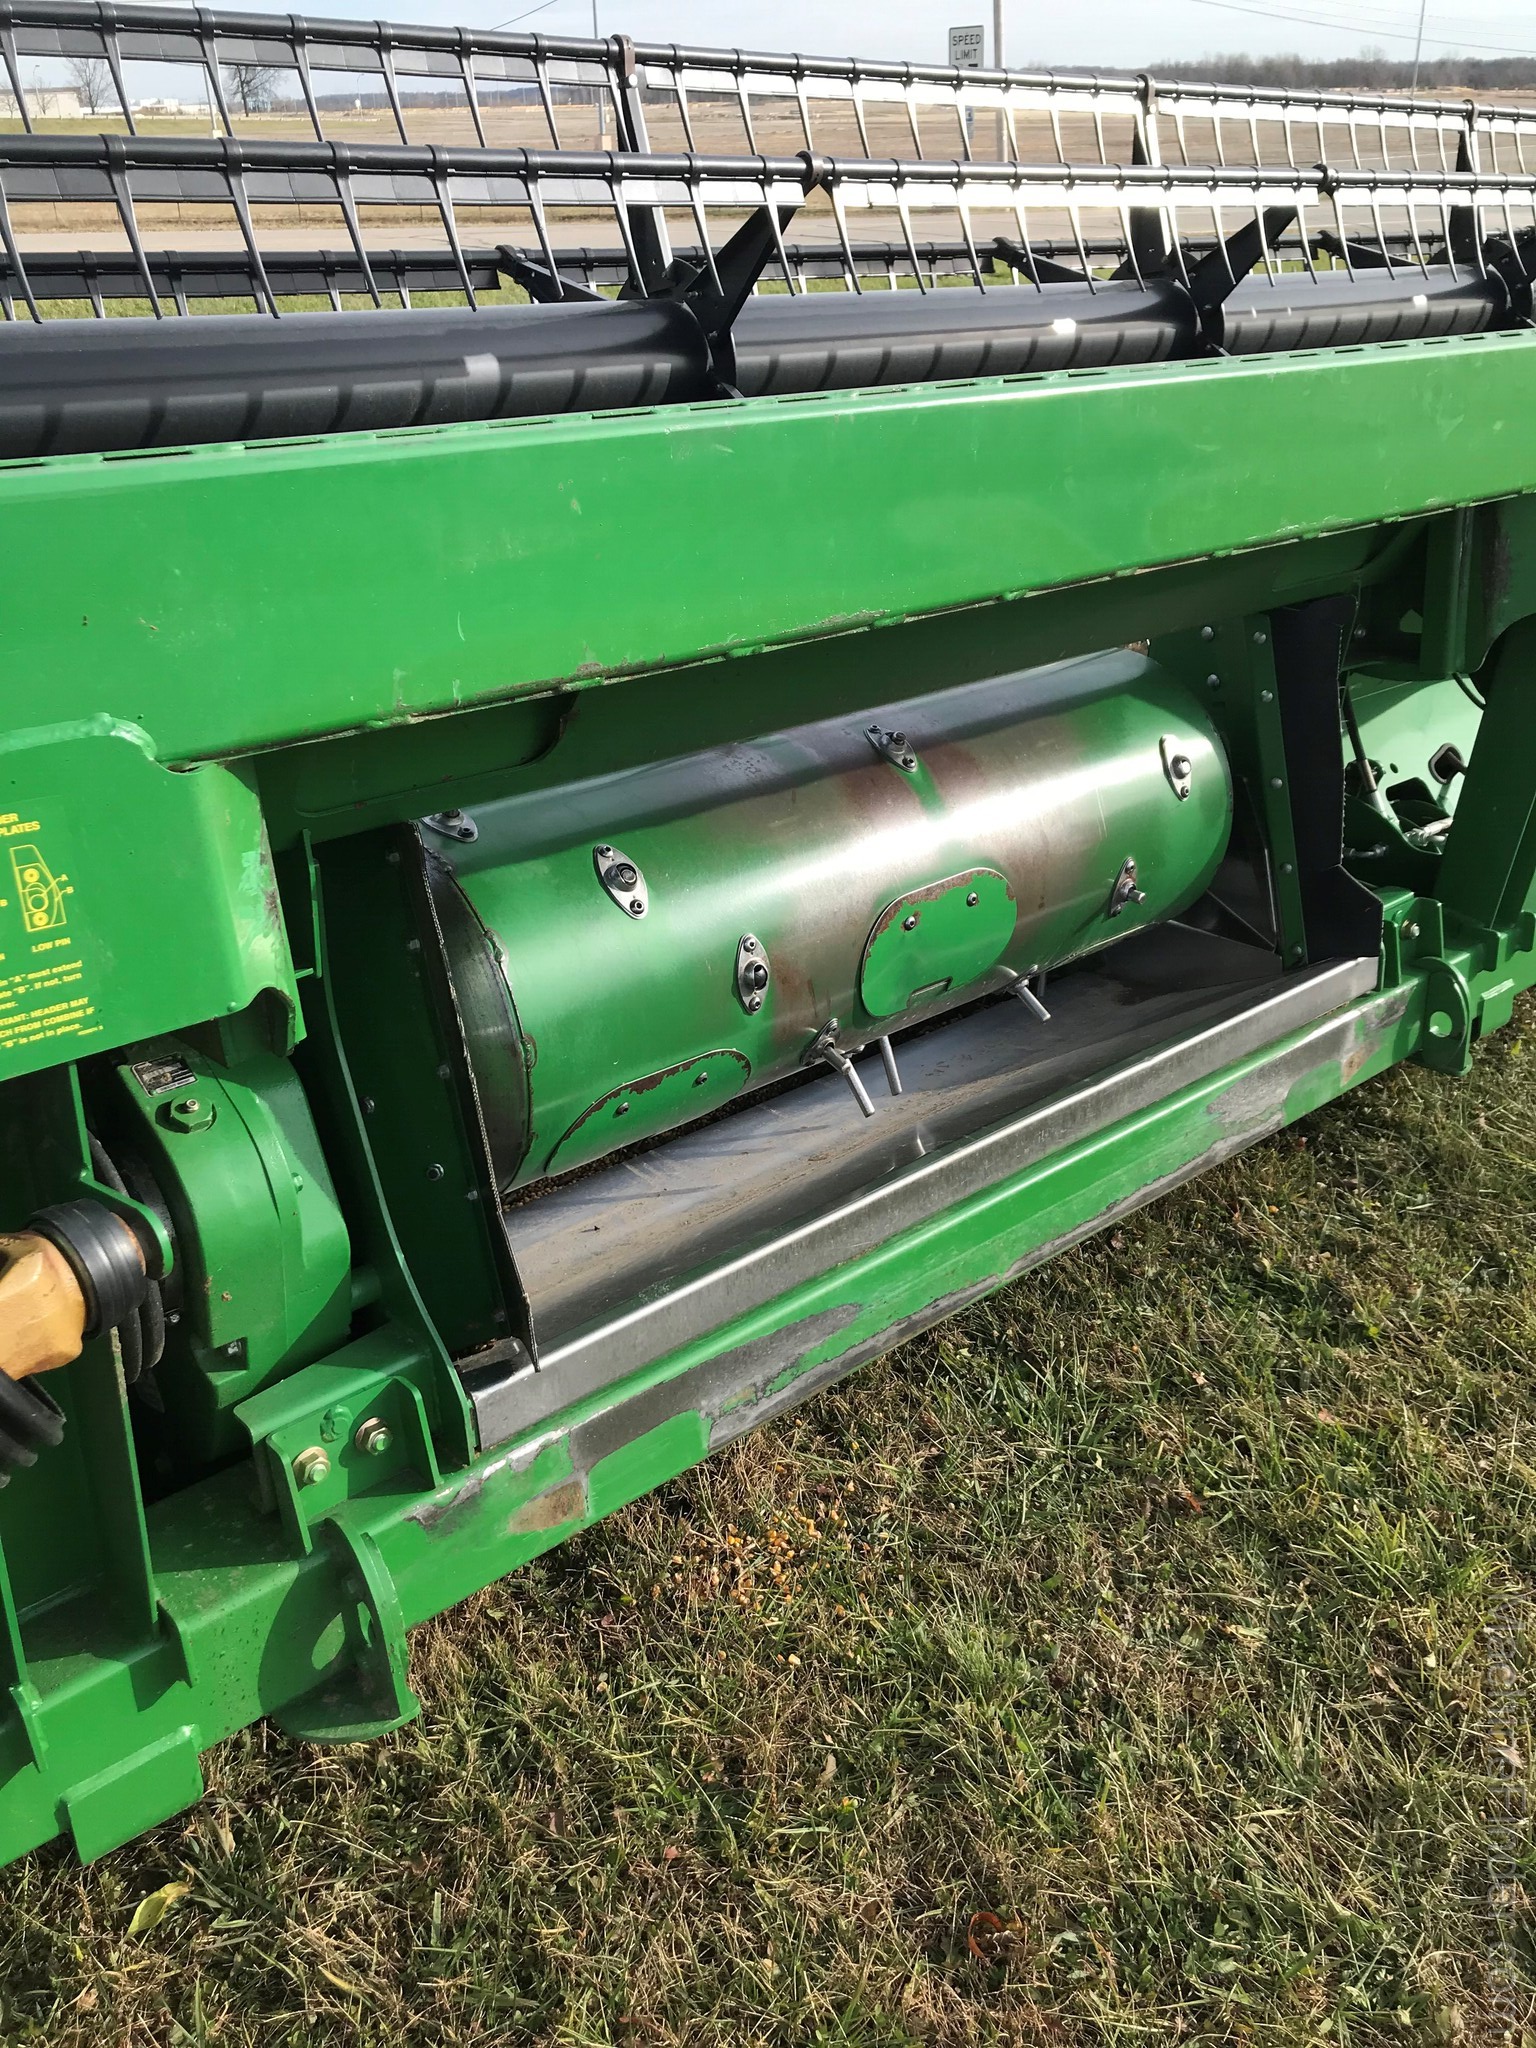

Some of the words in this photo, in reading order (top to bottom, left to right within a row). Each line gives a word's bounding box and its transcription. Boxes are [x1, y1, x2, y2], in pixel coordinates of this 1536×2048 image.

[952, 34, 981, 46] SPEED
[955, 48, 978, 60] LIMIT
[32, 942, 53, 952] LOW
[55, 938, 70, 947] PIN
[9, 974, 26, 983] "A"
[28, 969, 50, 979] must
[51, 960, 83, 973] extend
[34, 982, 42, 990] If
[63, 973, 82, 981] turn
[31, 1003, 68, 1017] HEADER
[70, 997, 88, 1007] MAY
[14, 1021, 41, 1033] FROM
[43, 1010, 84, 1025] COMBINE
[85, 1006, 95, 1015] IF
[29, 1032, 45, 1041] not
[45, 1029, 55, 1037] in
